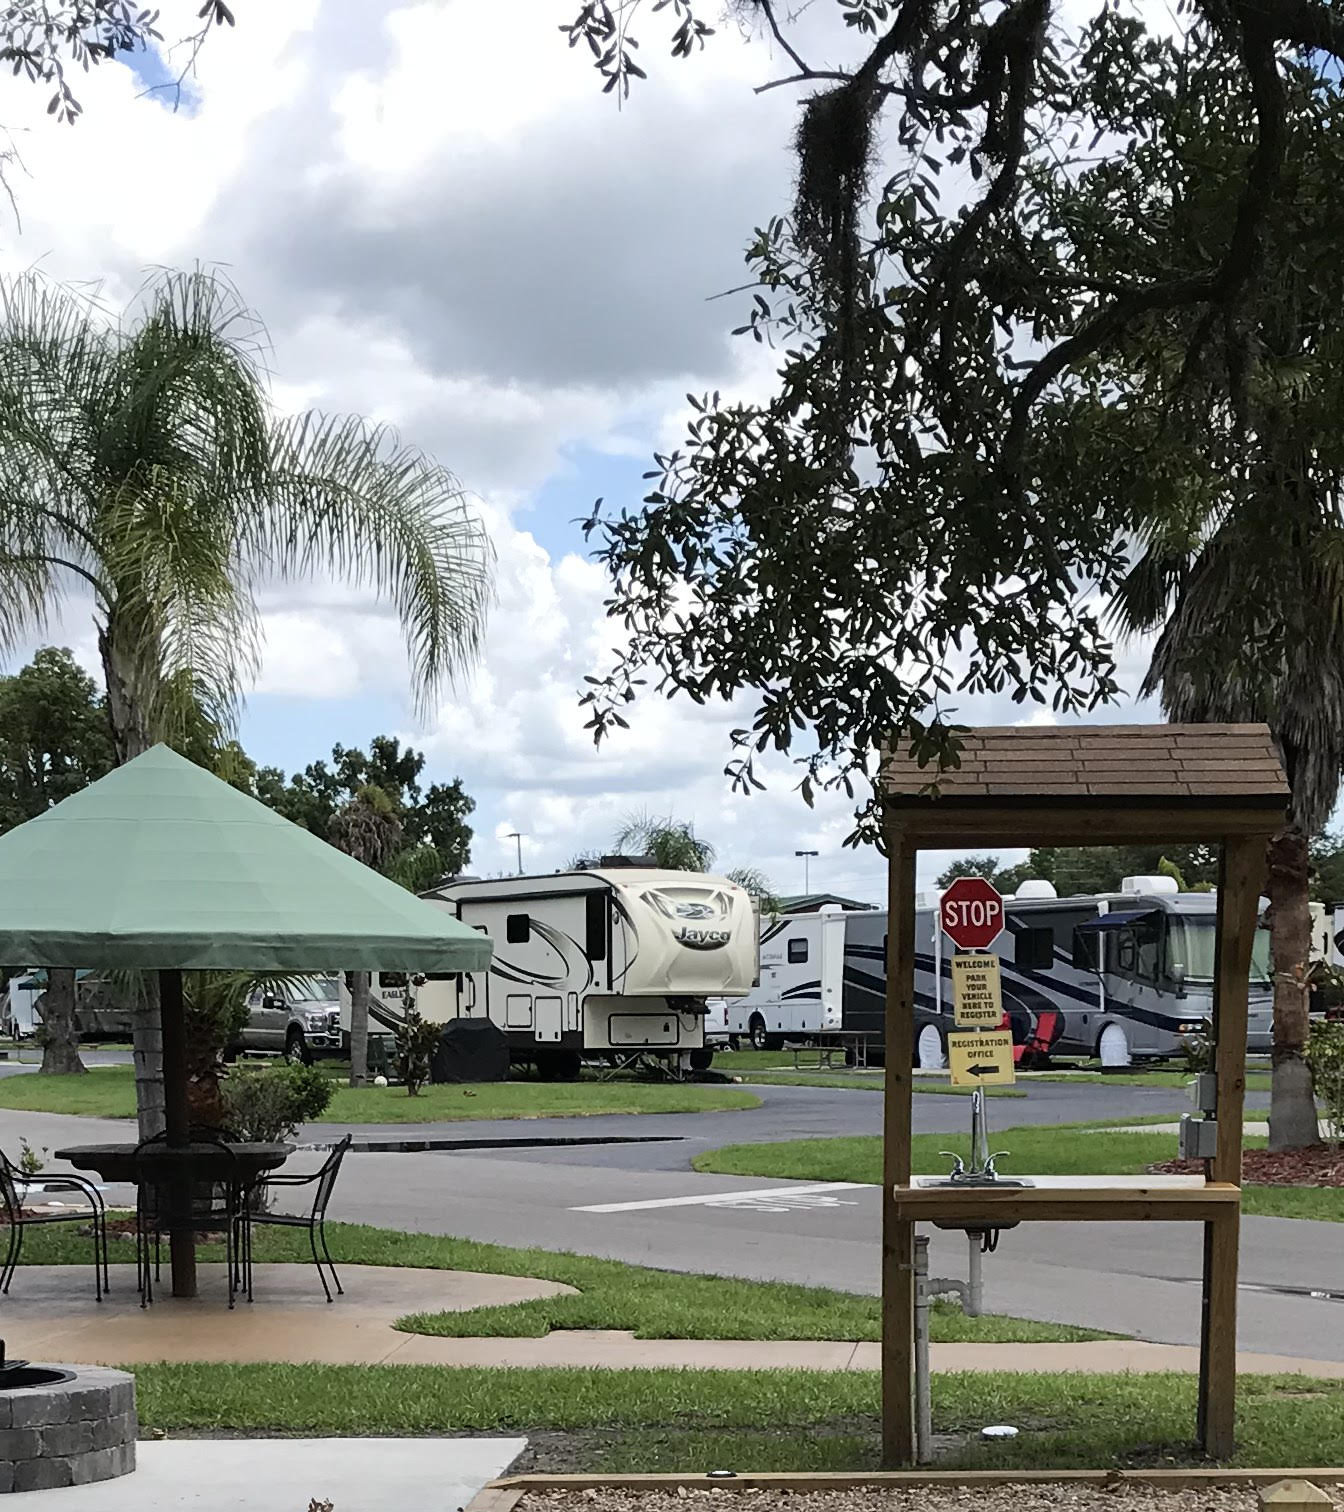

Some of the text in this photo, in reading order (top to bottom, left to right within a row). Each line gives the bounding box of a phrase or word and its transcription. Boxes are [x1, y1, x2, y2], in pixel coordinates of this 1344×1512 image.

[945, 900, 1000, 927] STOP
[674, 926, 731, 945] Jayco
[955, 960, 996, 969] WELCOME
[966, 974, 987, 982] PARK
[966, 983, 987, 991] YOUR
[961, 992, 993, 1000] VEHICLE
[962, 1001, 994, 1010] HERE TO
[960, 1010, 997, 1019] REGISTER
[951, 1038, 1009, 1048] REGISTRATION
[967, 1049, 994, 1059] OFFICE
